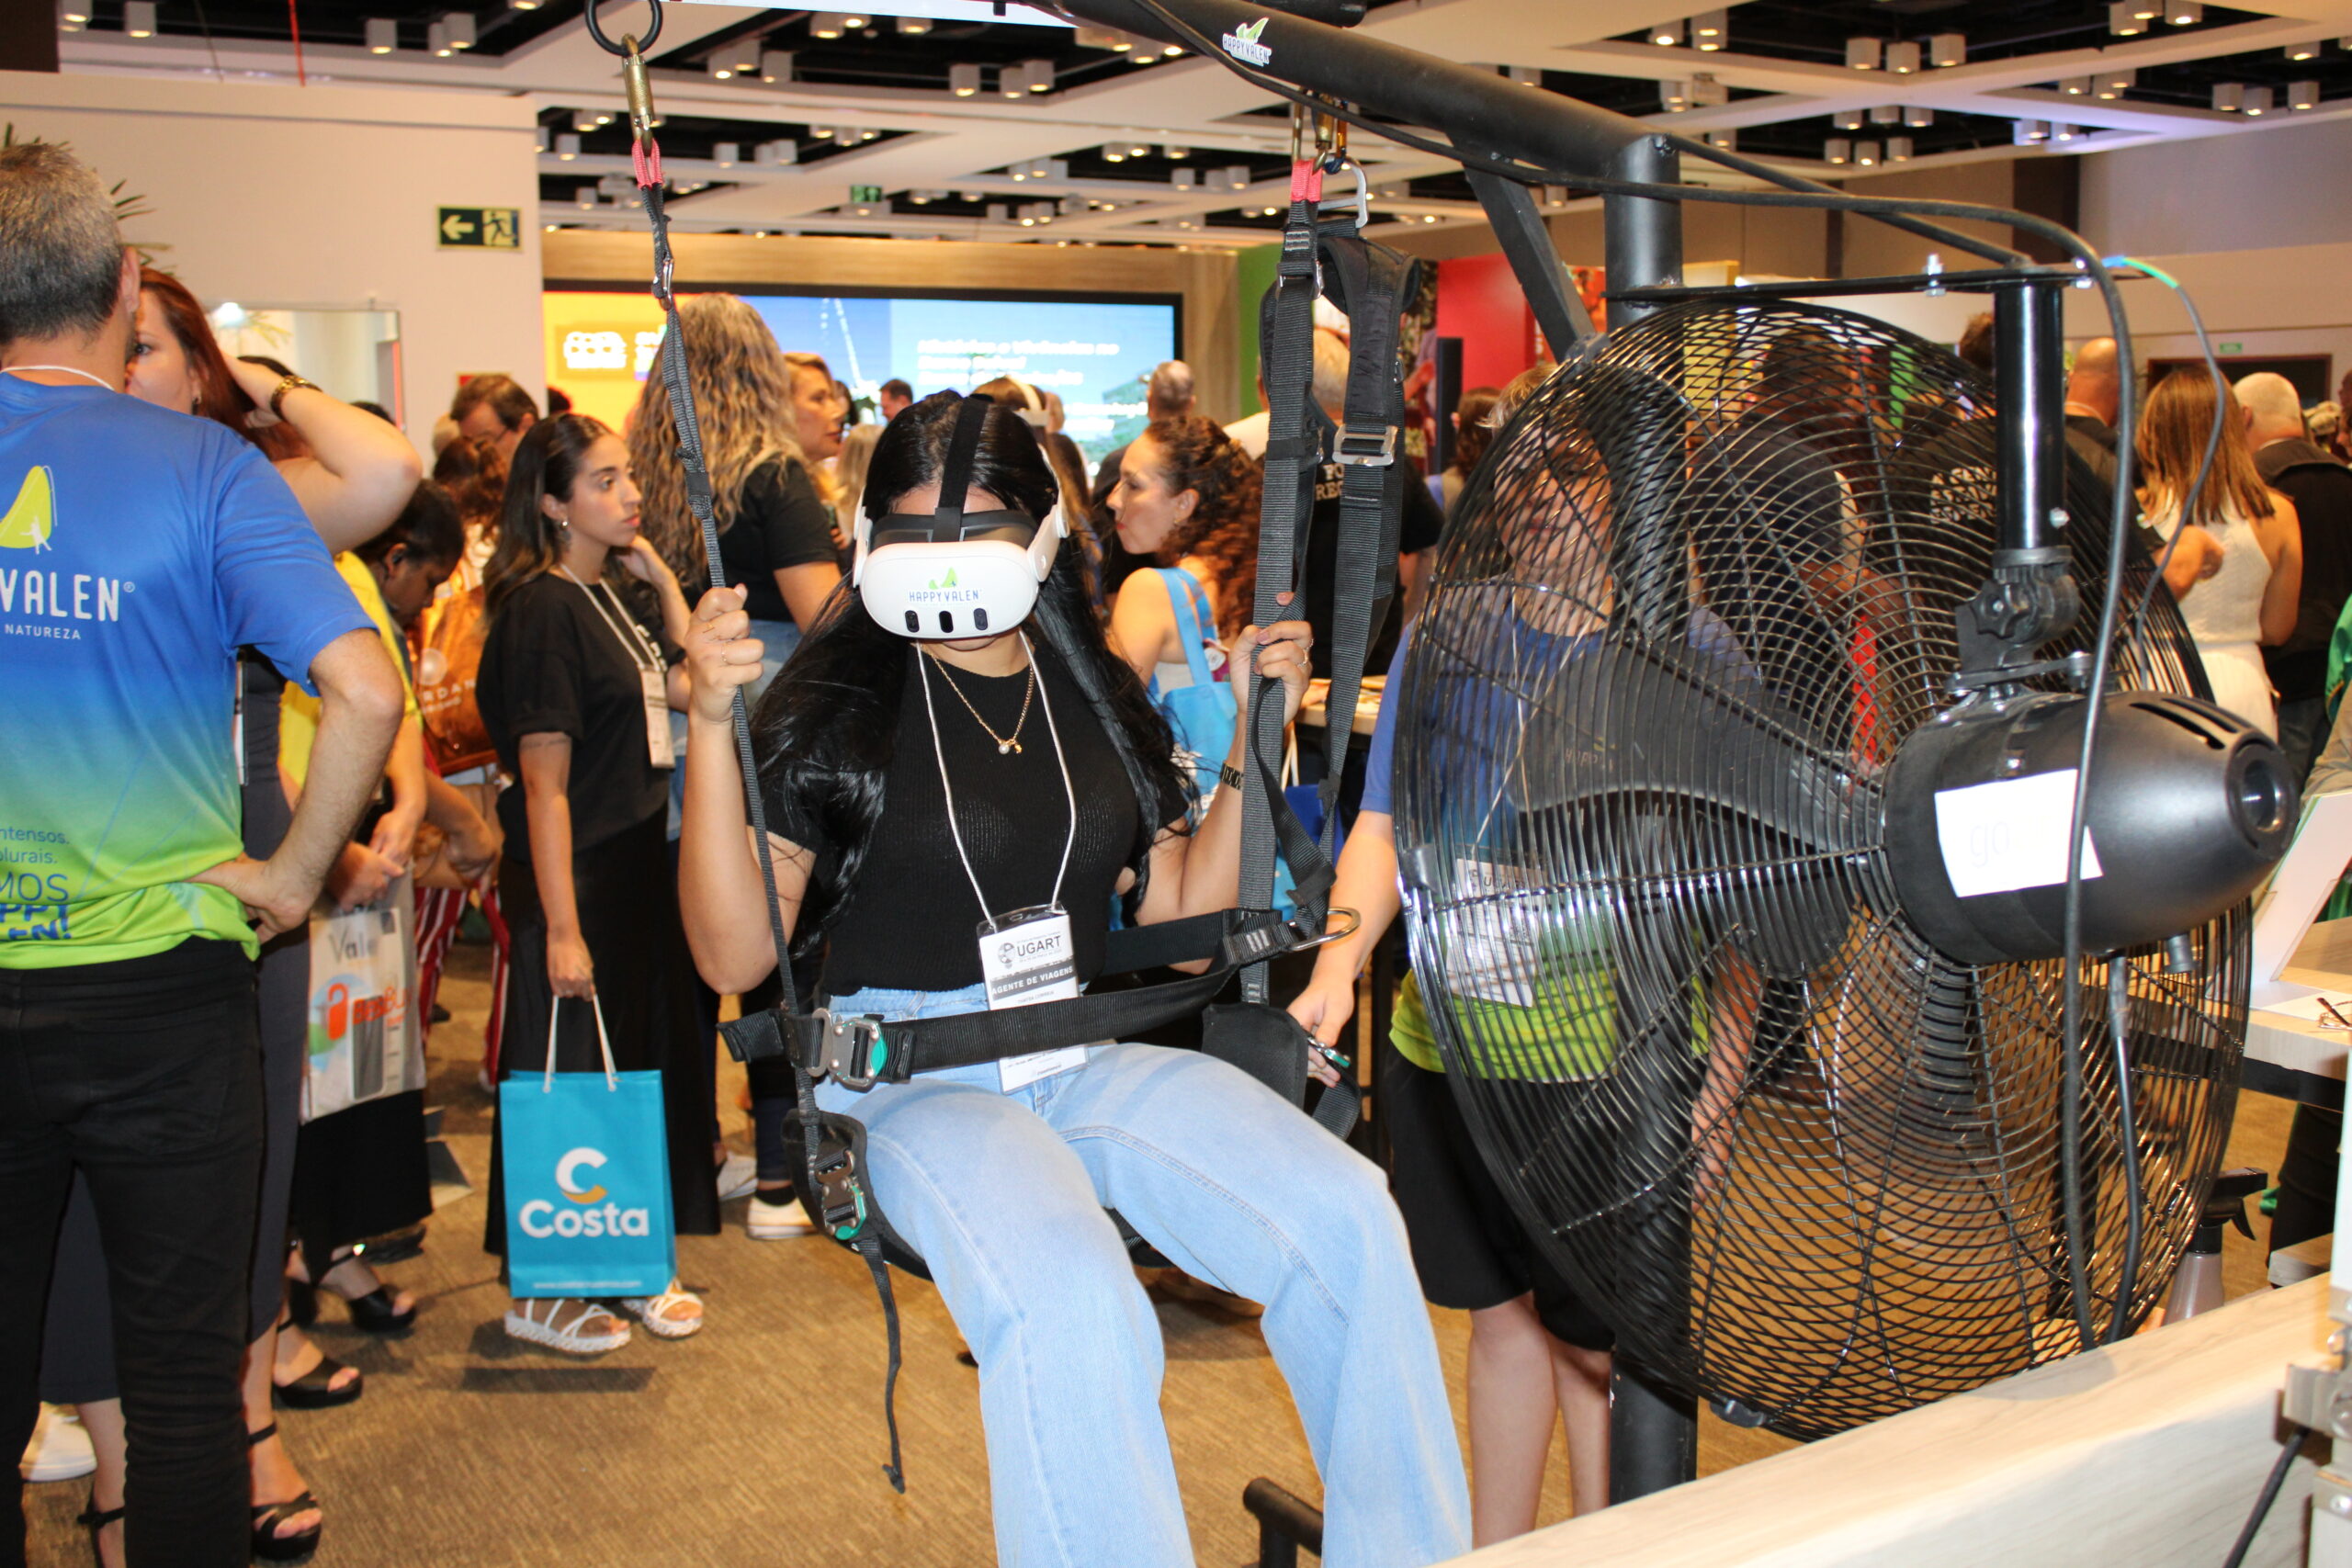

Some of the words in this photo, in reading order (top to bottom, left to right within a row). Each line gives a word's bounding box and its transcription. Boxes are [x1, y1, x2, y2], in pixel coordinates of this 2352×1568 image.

[5, 624, 81, 640] NATUREZA
[1017, 935, 1061, 957] UGART
[992, 980, 1024, 996] AGENTE
[1026, 976, 1038, 987] DE
[1039, 965, 1074, 982] VIAGENS
[518, 1199, 650, 1239] Costa
